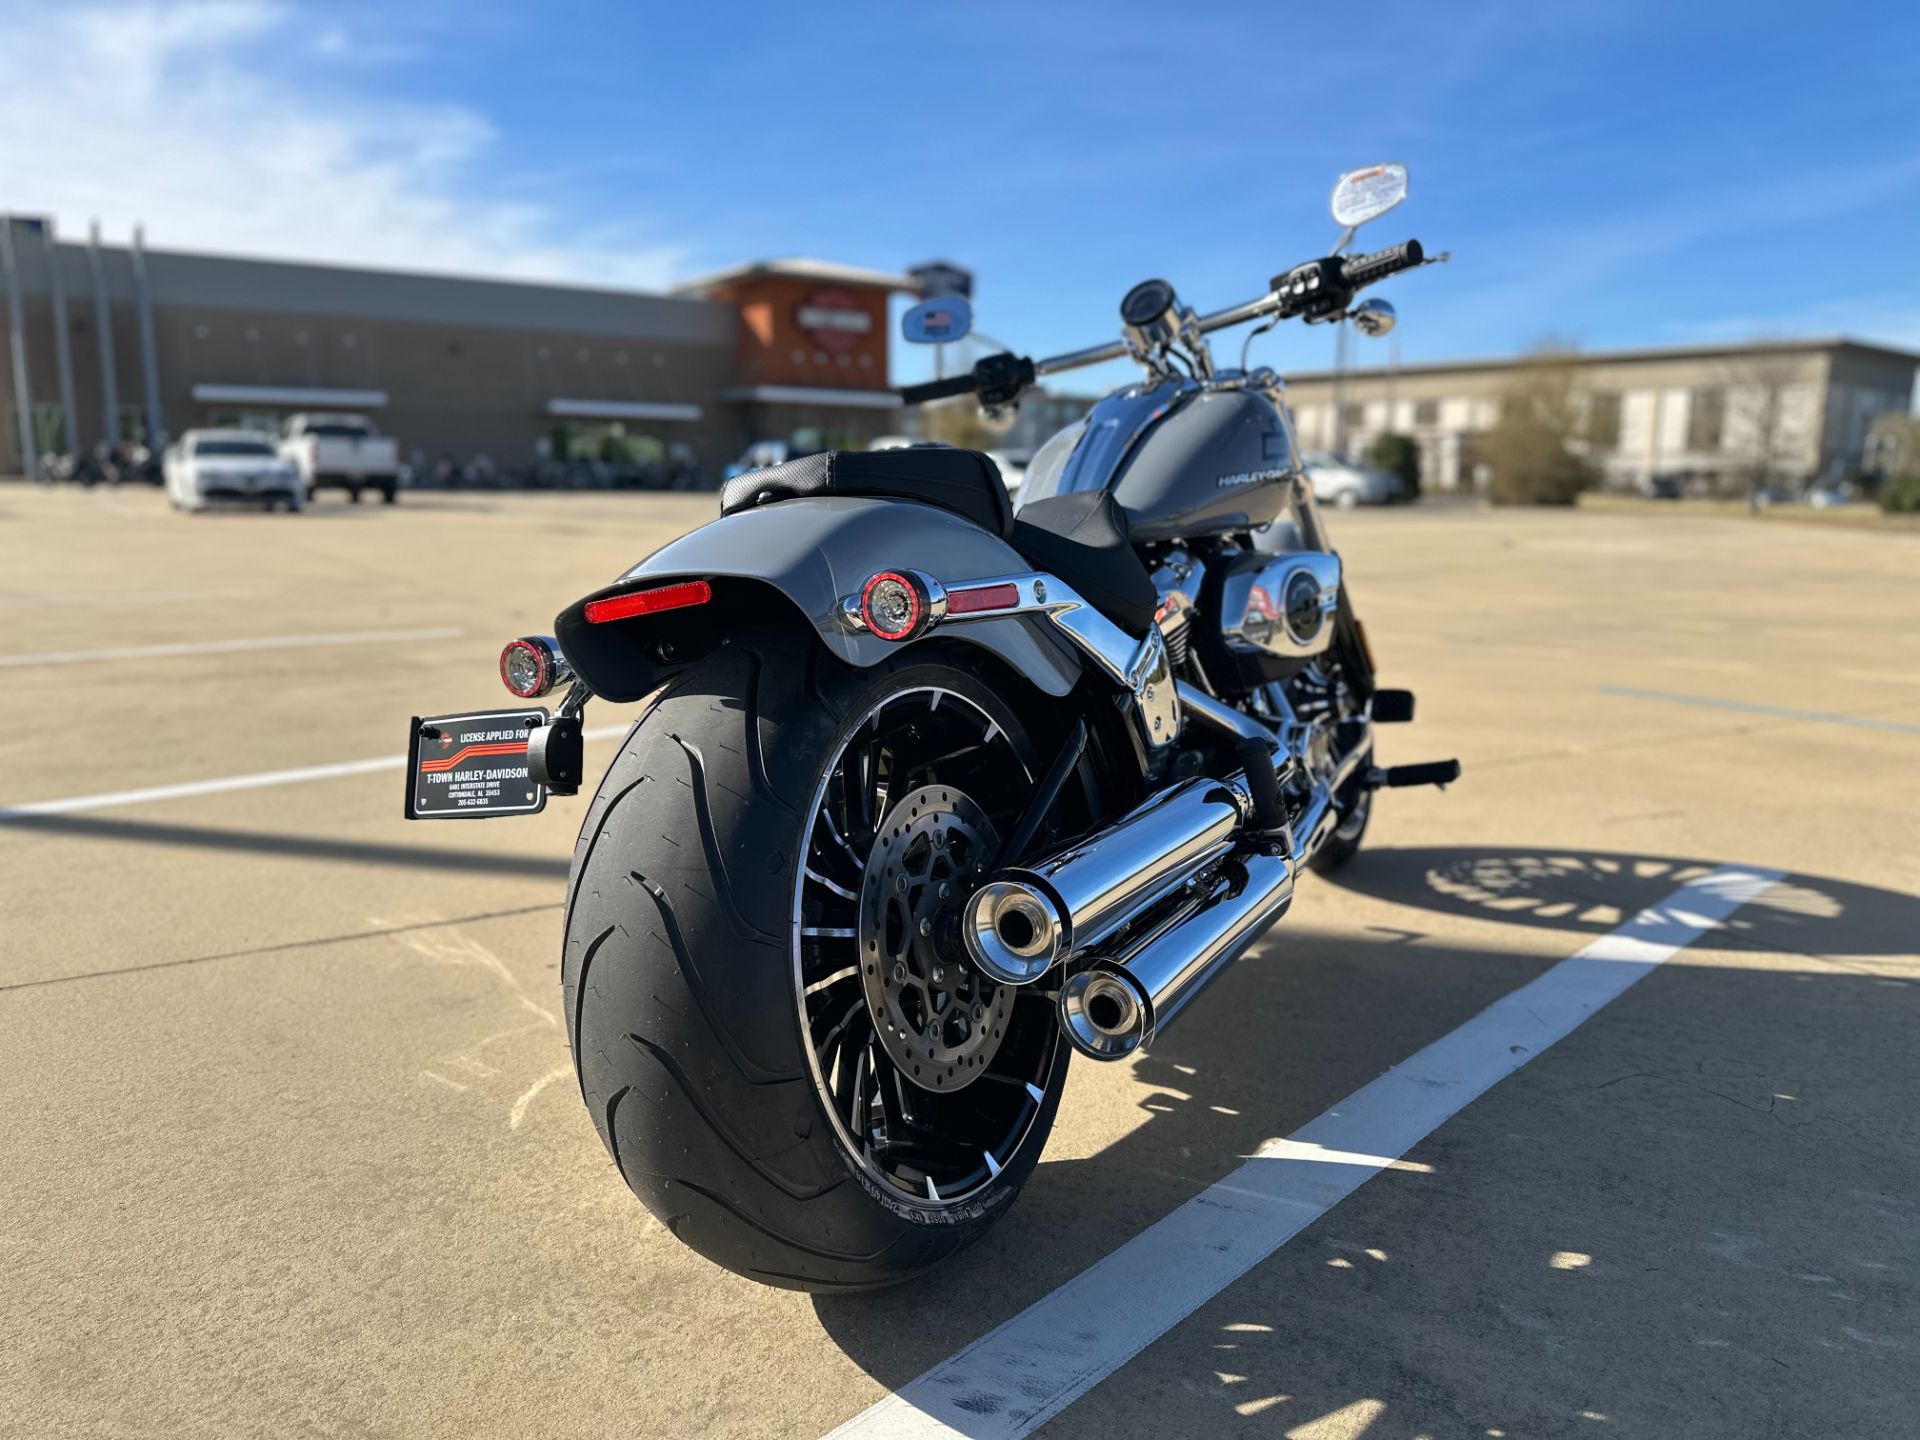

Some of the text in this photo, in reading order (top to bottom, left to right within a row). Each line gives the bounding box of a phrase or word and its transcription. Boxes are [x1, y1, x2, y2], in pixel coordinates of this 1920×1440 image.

[460, 732, 485, 743] LICENSE
[486, 730, 514, 741] APPLIED
[515, 729, 529, 739] FOR
[427, 767, 528, 783] T-TOWN HARLEY-DAVIDSON
[460, 782, 485, 790] INTERSTATE
